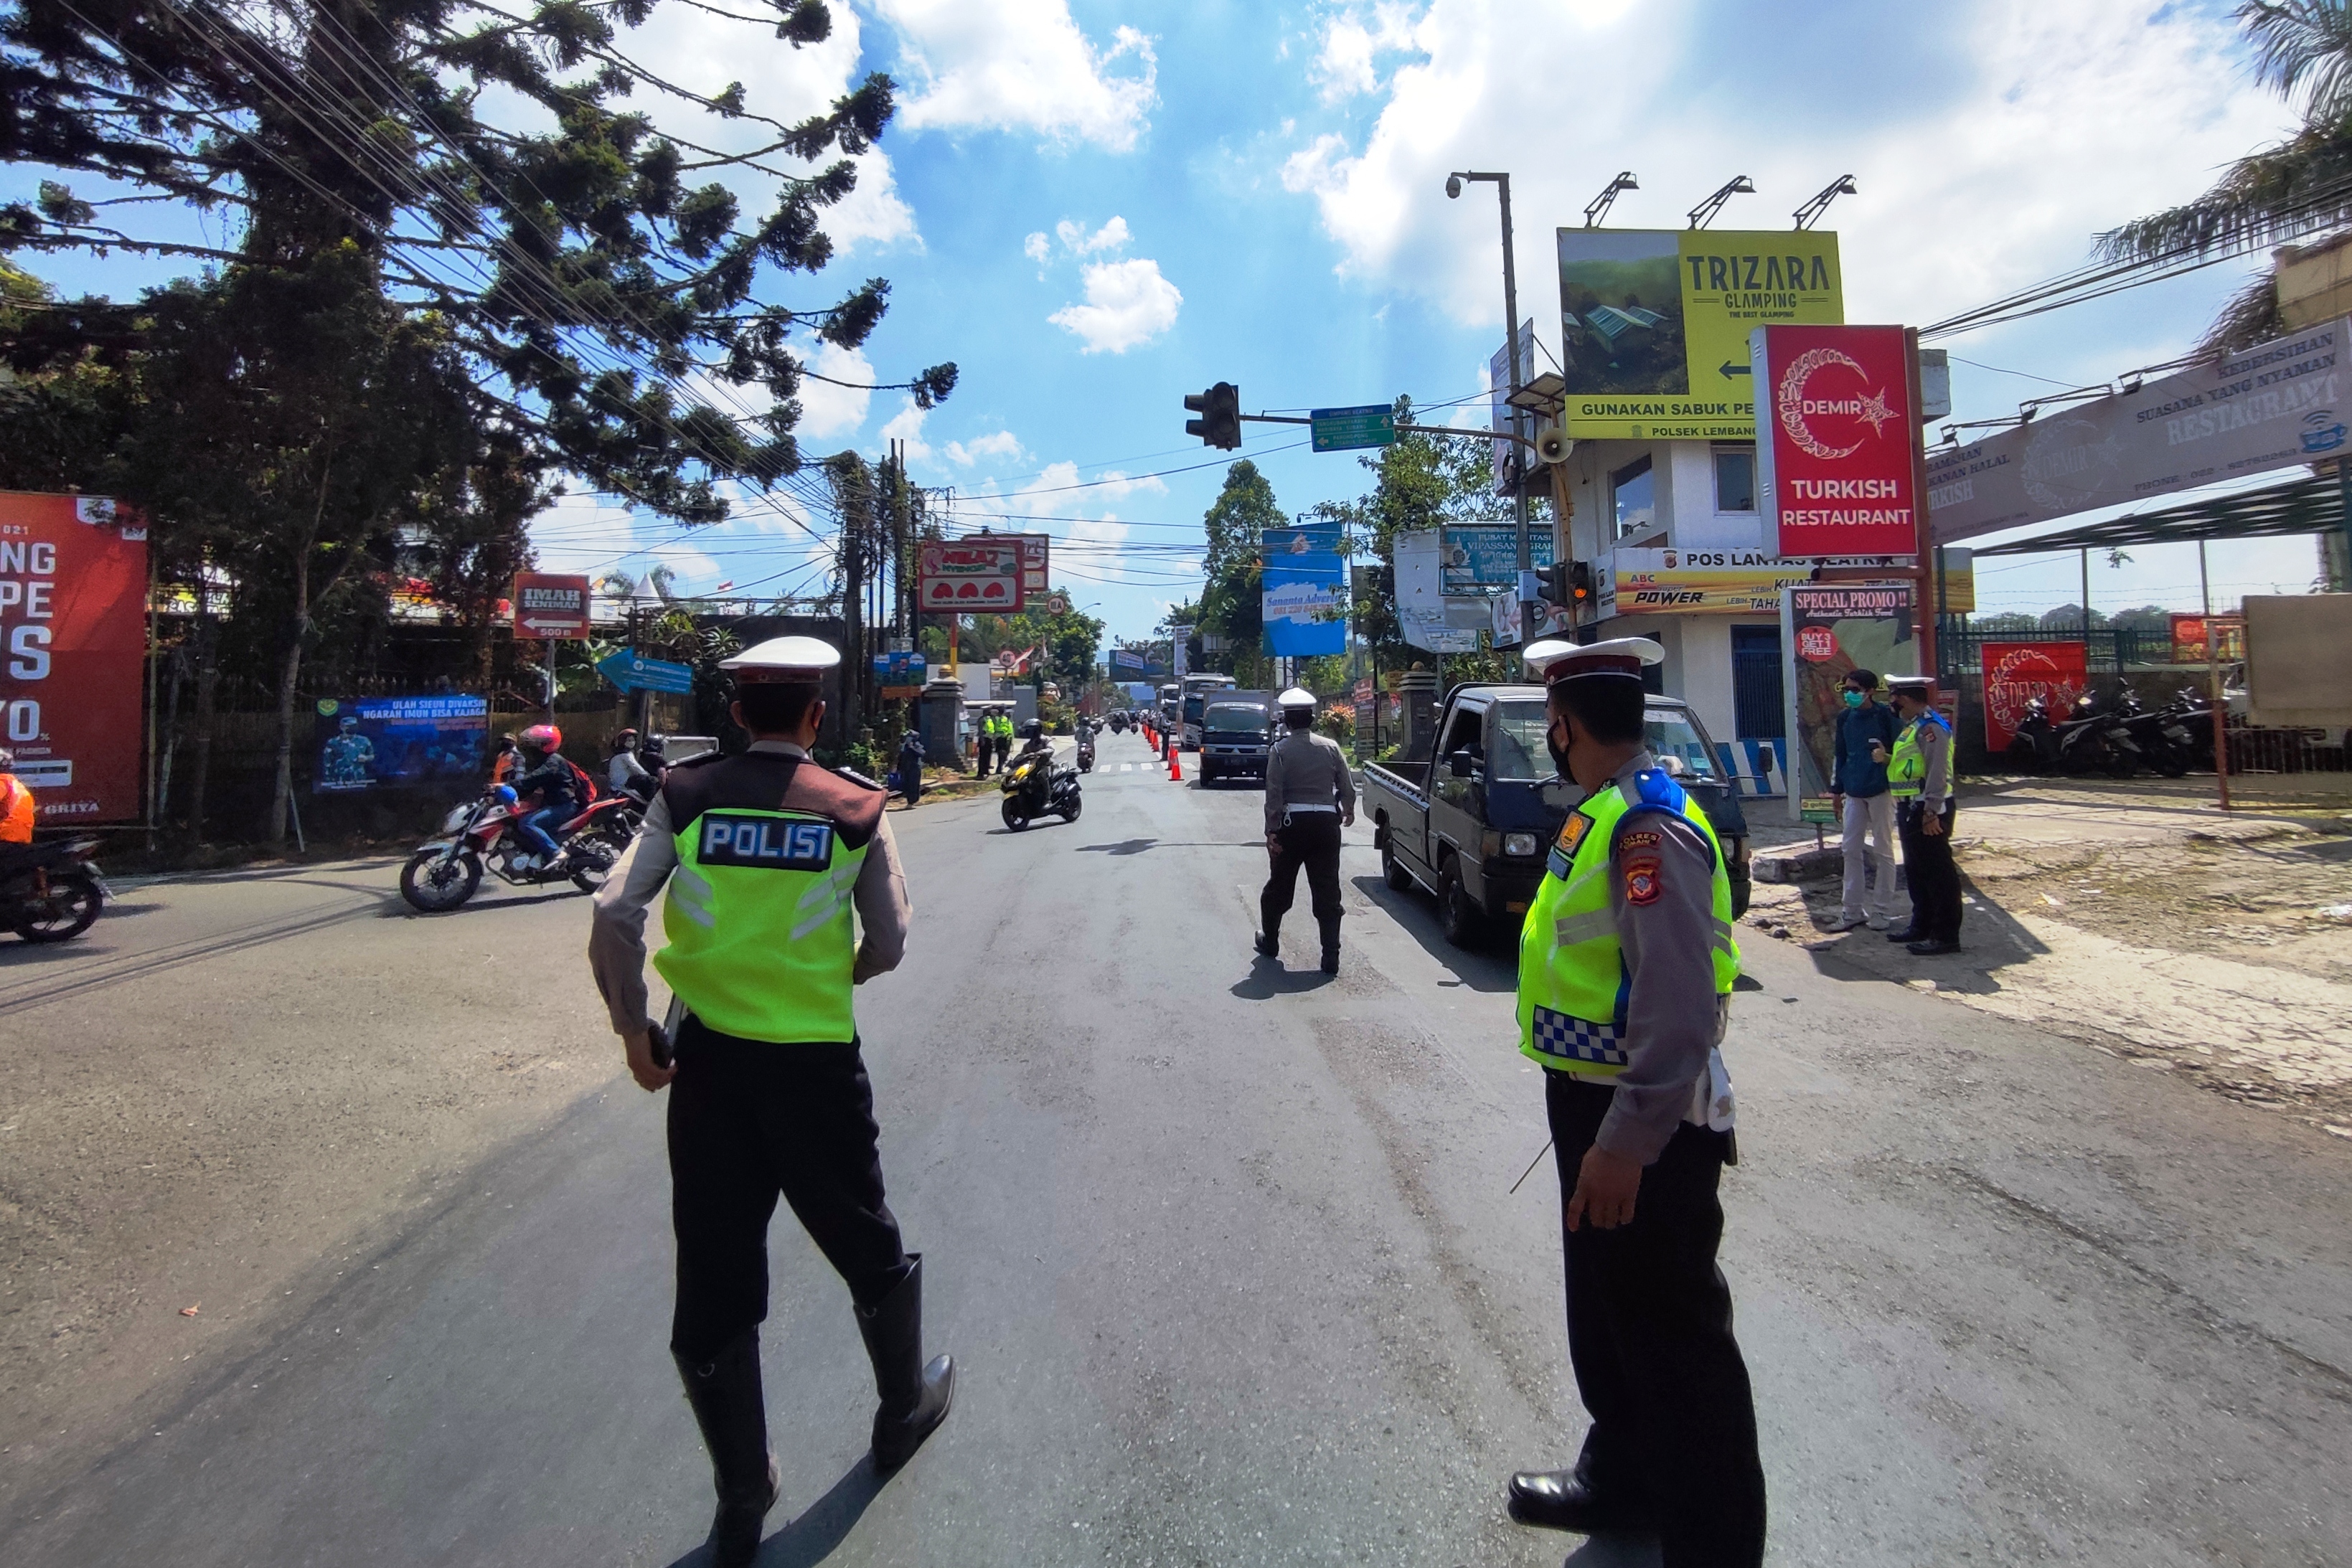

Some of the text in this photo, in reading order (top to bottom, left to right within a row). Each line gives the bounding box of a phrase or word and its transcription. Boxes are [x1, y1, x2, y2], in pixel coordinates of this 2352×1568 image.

[1687, 255, 1830, 291] TRIZARA
[1724, 293, 1797, 308] GLAMPING
[2216, 332, 2333, 379] KEBERSIHAN
[2137, 353, 2336, 423] SUASANA YANG NYAMAN
[1581, 403, 1665, 415] GUNAKAN
[1671, 403, 1728, 415] SABUK
[1802, 400, 1861, 415] DEMIR
[1652, 428, 1699, 436] POLSEK
[1970, 454, 2010, 474] HALAL
[1790, 479, 1897, 500] TURKISH
[2134, 475, 2179, 492] PHONE
[1782, 509, 1910, 526] RESTAURANT
[1687, 553, 1725, 566] POS
[1630, 574, 1655, 583] ABC
[525, 588, 580, 601] IMAH
[1634, 592, 1703, 606] POWER
[1795, 592, 1908, 610] SPECIAL PROMO !!
[524, 600, 580, 609] SENIMAN
[1749, 598, 1780, 610] TAHA
[392, 701, 417, 709] ULAH
[363, 709, 401, 719] NGARAH
[431, 709, 451, 717] BISA
[454, 707, 486, 716] KAJAGA
[44, 802, 100, 816] GRIYA
[705, 823, 830, 861] POLISI
